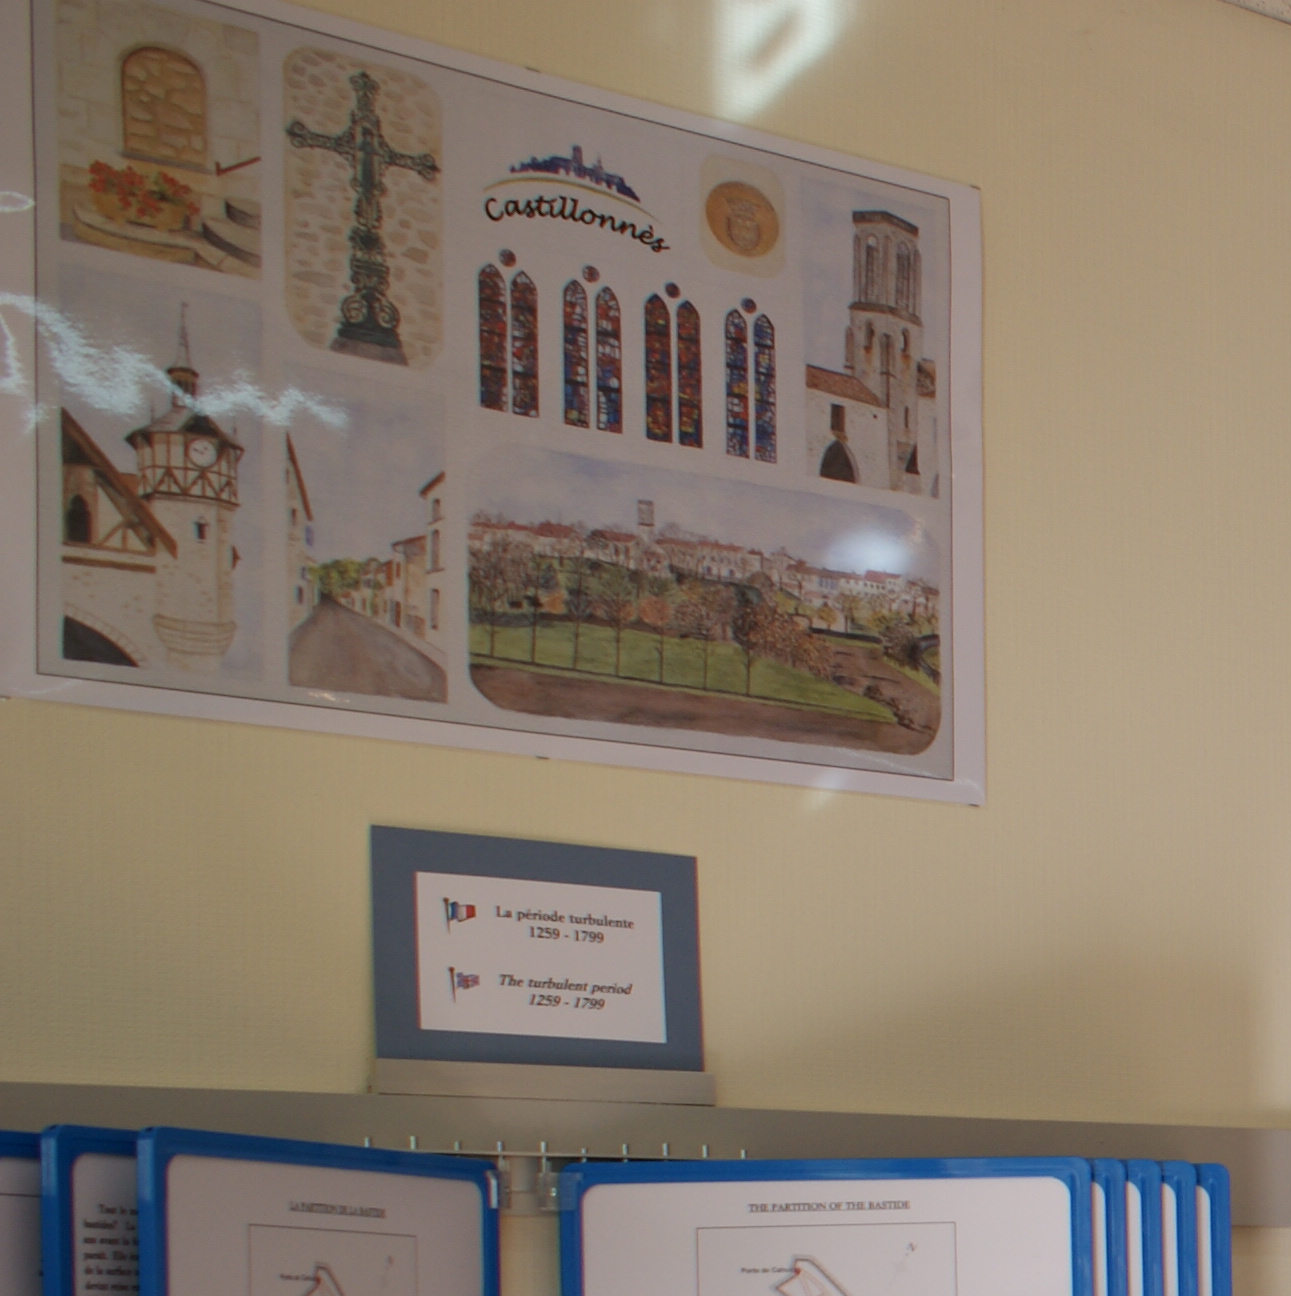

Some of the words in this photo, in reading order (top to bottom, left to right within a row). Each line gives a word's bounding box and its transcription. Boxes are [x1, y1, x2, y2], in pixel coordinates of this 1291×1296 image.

[484, 195, 671, 253] Castillonnès
[496, 905, 512, 919] La
[517, 908, 566, 924] période
[569, 913, 634, 930] turbulente
[529, 926, 560, 940] 1259
[574, 930, 604, 944] 1799
[499, 974, 524, 988] The
[528, 977, 588, 992] turbulent
[591, 982, 633, 996] period
[529, 994, 561, 1008] 1259
[574, 997, 605, 1011] 1799
[749, 1203, 768, 1213] THE
[771, 1202, 826, 1212] PARTITION
[829, 1201, 841, 1211] OF
[846, 1201, 865, 1210] THE
[868, 1200, 911, 1210] BASTIDE
